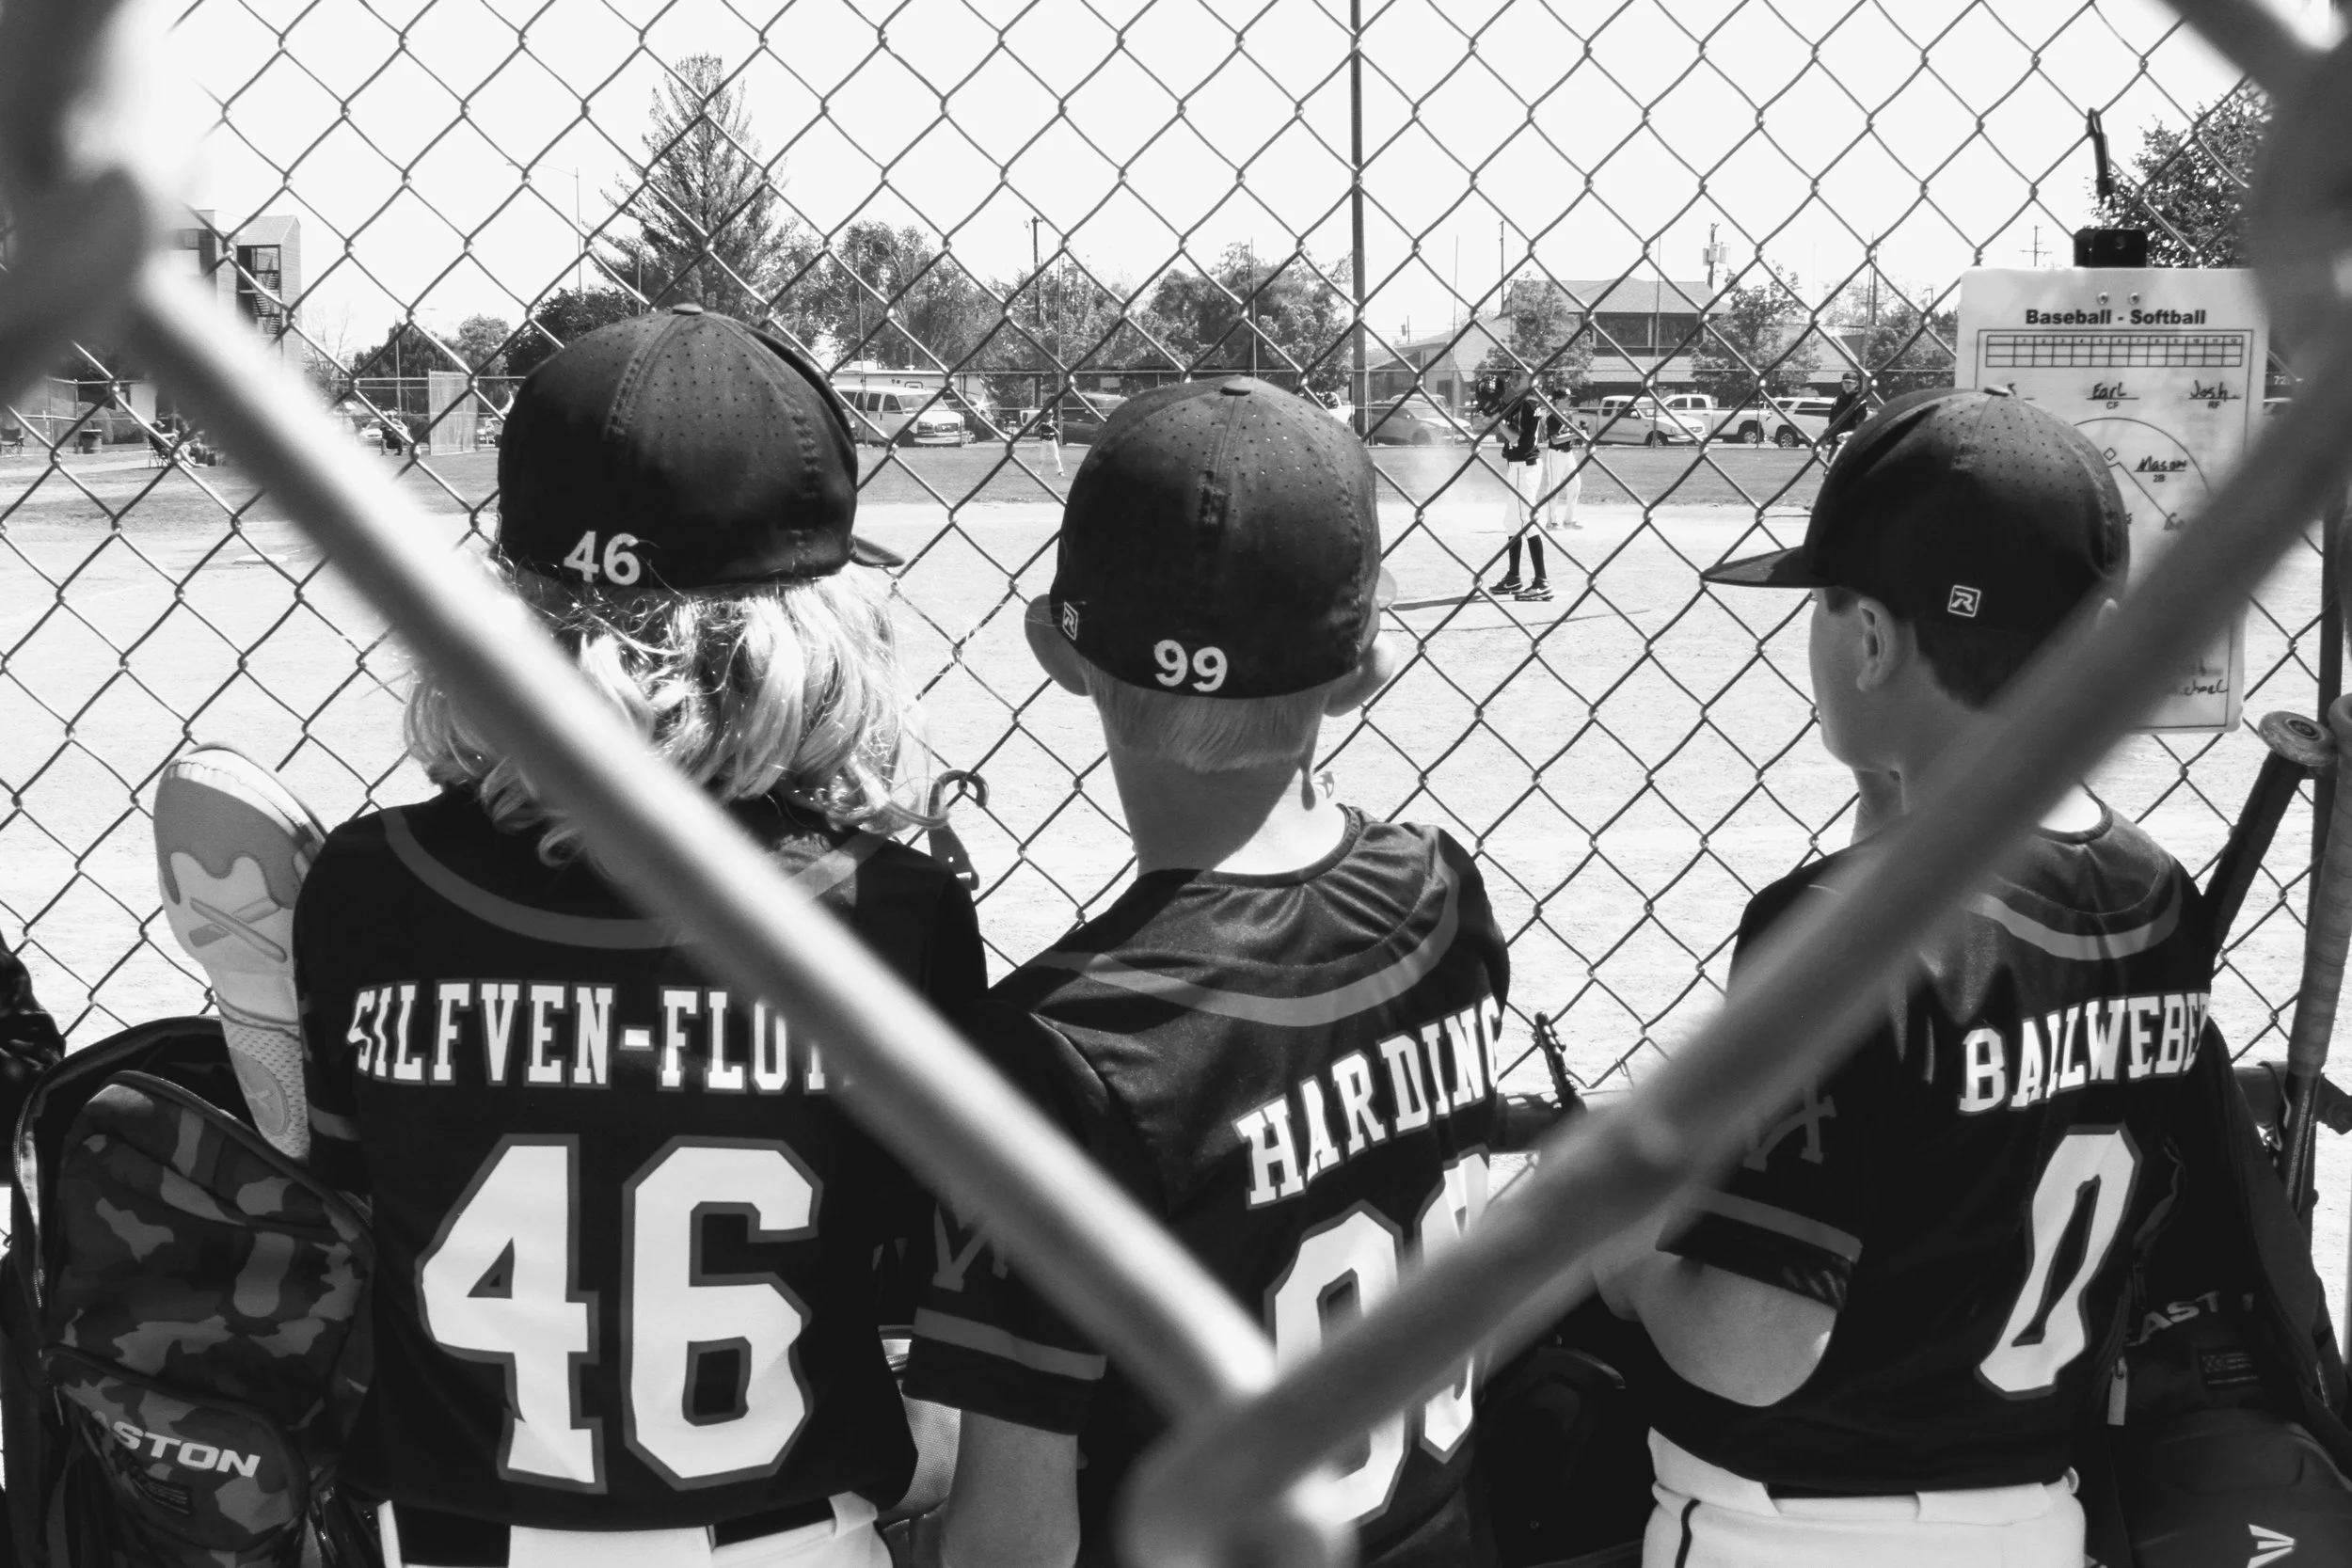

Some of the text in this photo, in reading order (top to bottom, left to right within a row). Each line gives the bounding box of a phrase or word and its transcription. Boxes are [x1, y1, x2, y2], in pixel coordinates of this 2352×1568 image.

[2026, 309, 2111, 325] Baseball
[2130, 309, 2206, 325] Softball
[2106, 401, 2119, 410] CF
[2207, 401, 2220, 409] RF
[2136, 455, 2187, 471] Mason
[564, 531, 641, 585] 46
[1153, 640, 1228, 692] 99
[420, 1143, 816, 1485] 46
